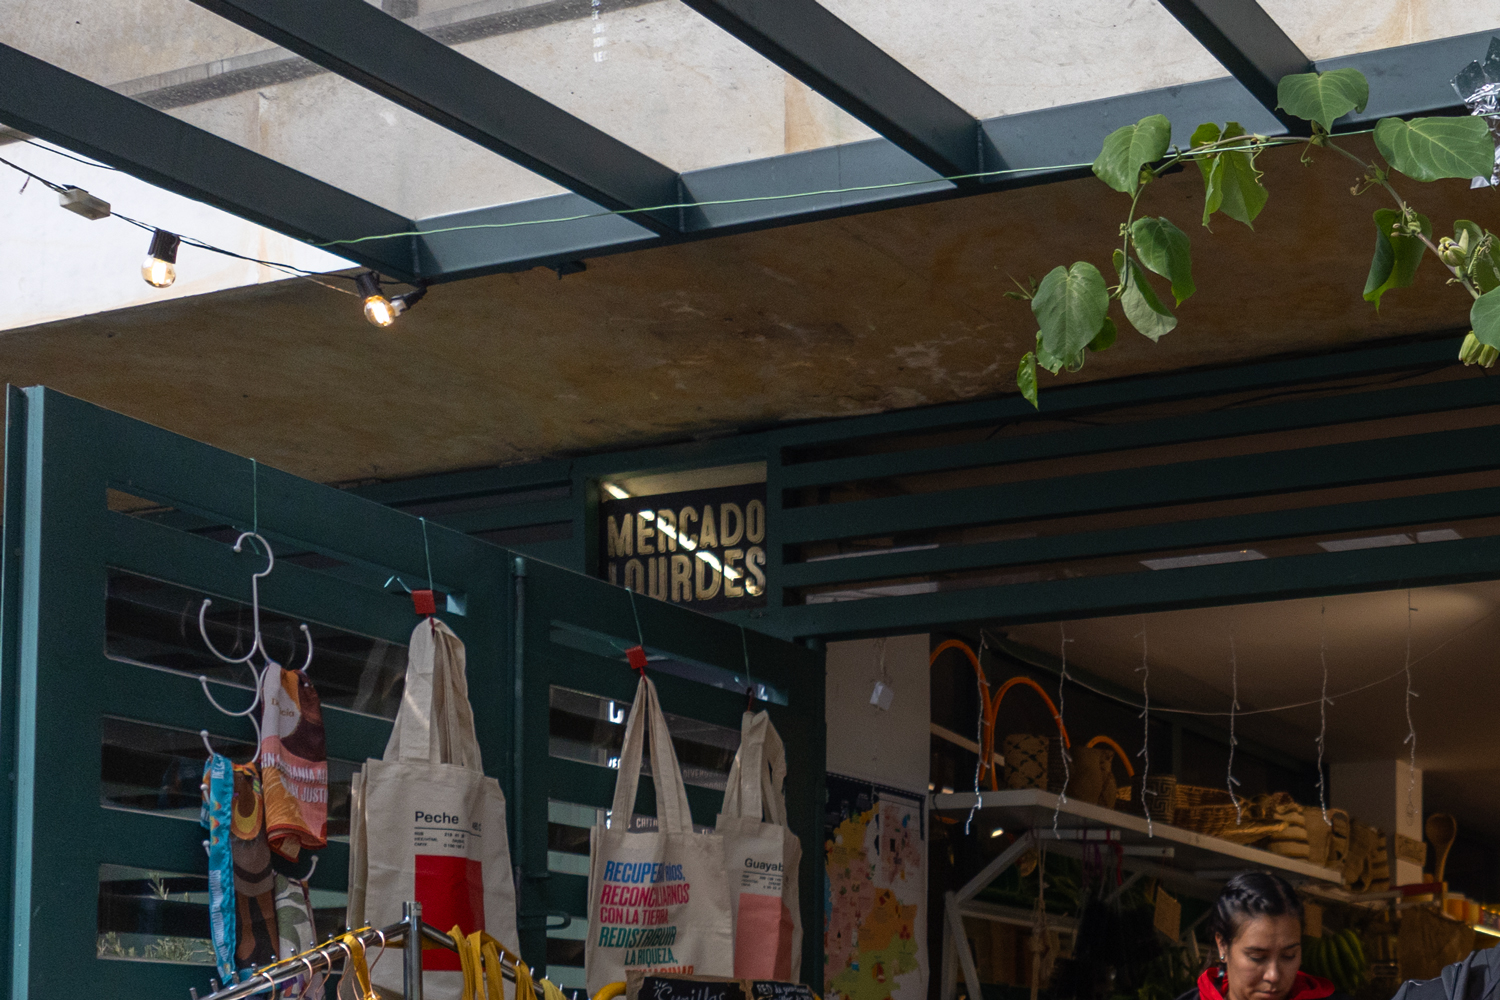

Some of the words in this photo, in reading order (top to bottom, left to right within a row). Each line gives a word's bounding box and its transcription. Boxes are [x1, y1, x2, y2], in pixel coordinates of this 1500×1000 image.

[607, 499, 766, 558] MERCADO
[415, 811, 459, 824] Peche
[600, 907, 624, 924] CON
[625, 909, 639, 925] LA
[598, 926, 677, 948] REDISTRIBUIR
[624, 949, 636, 965] LA
[637, 948, 679, 967] RIQUEZA,
